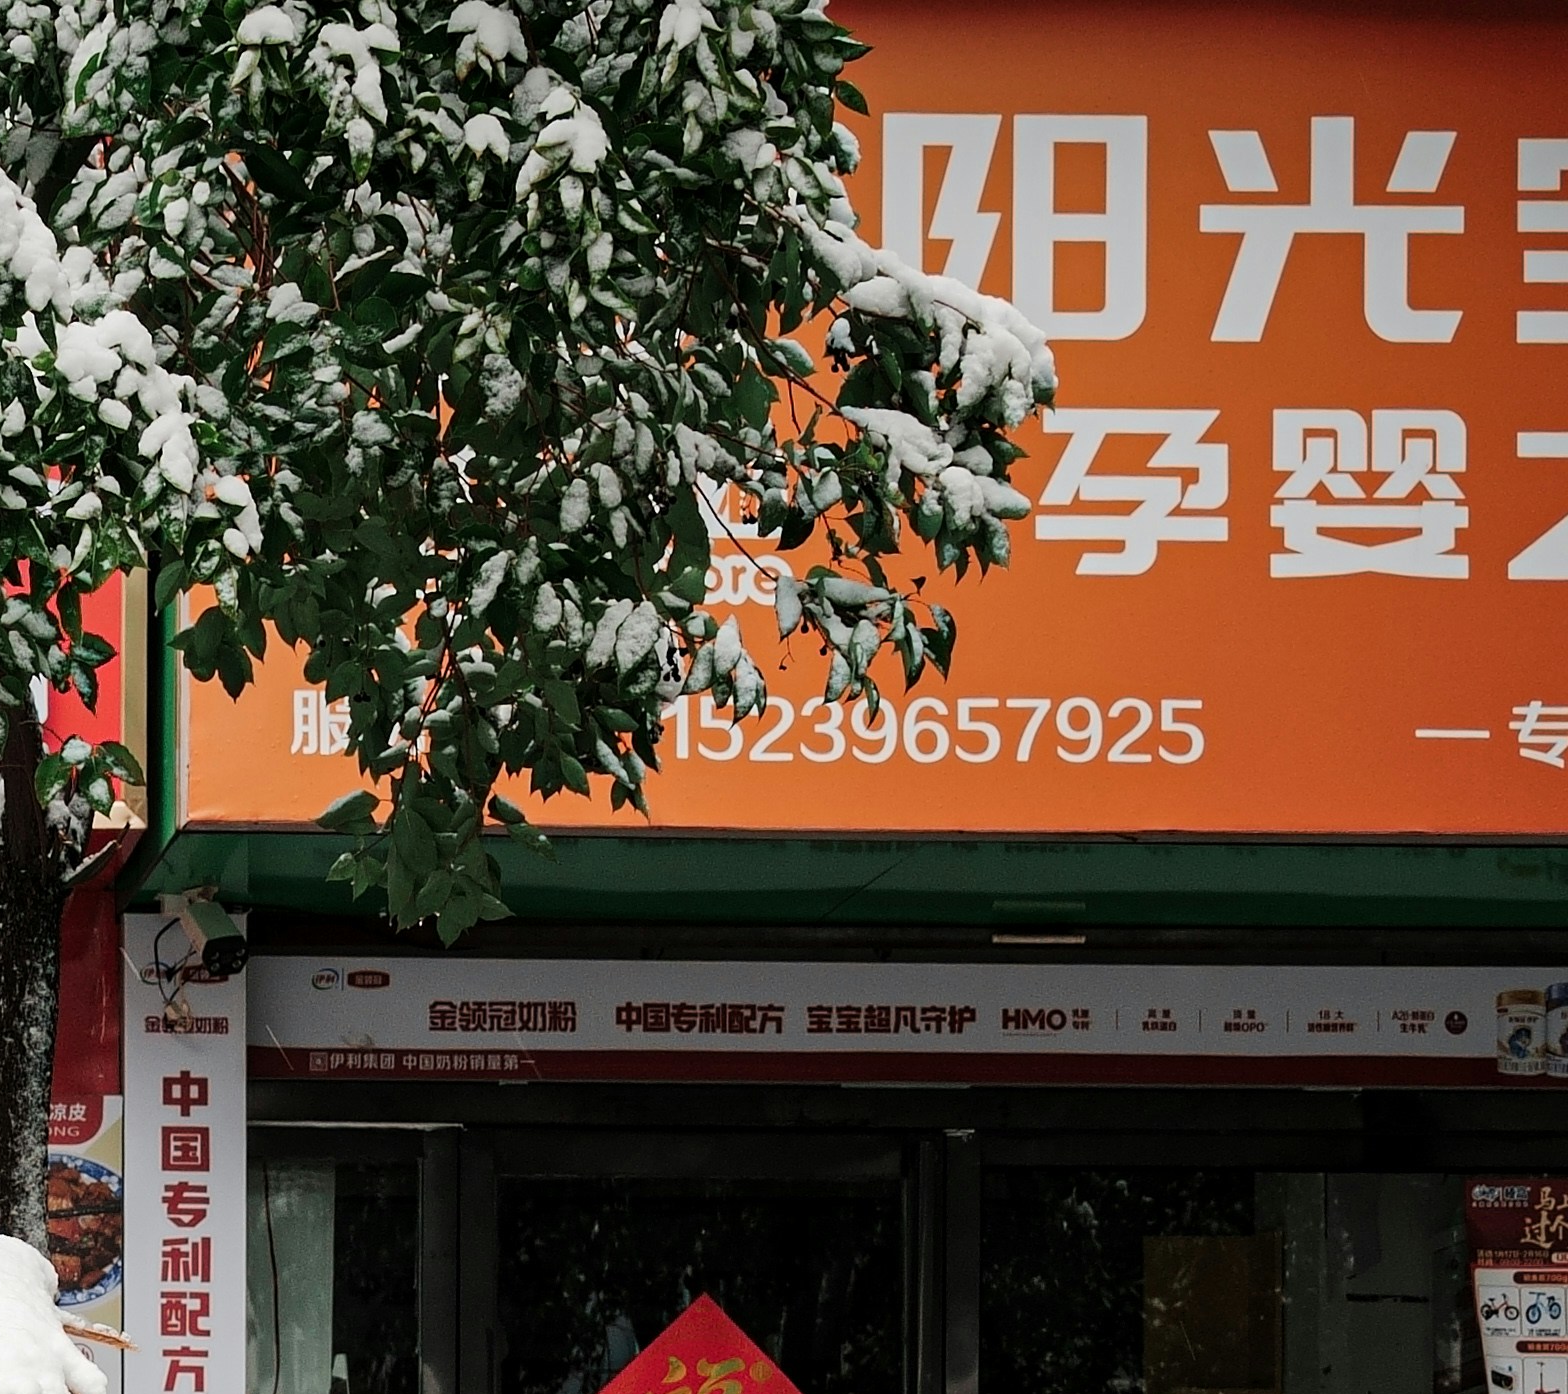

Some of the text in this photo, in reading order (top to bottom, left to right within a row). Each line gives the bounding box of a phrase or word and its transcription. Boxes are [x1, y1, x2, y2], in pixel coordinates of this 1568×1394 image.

[661, 695, 1205, 765] 15239657925
[145, 1015, 229, 1035] 金奶粉
[428, 1001, 1067, 1035] 金领冠奶粉 中国专利配方 宝宝超凡守护 HMO
[330, 1053, 535, 1071] 伊利集团 中国奶粉销量第一
[160, 1070, 211, 1393] 中国专利配方
